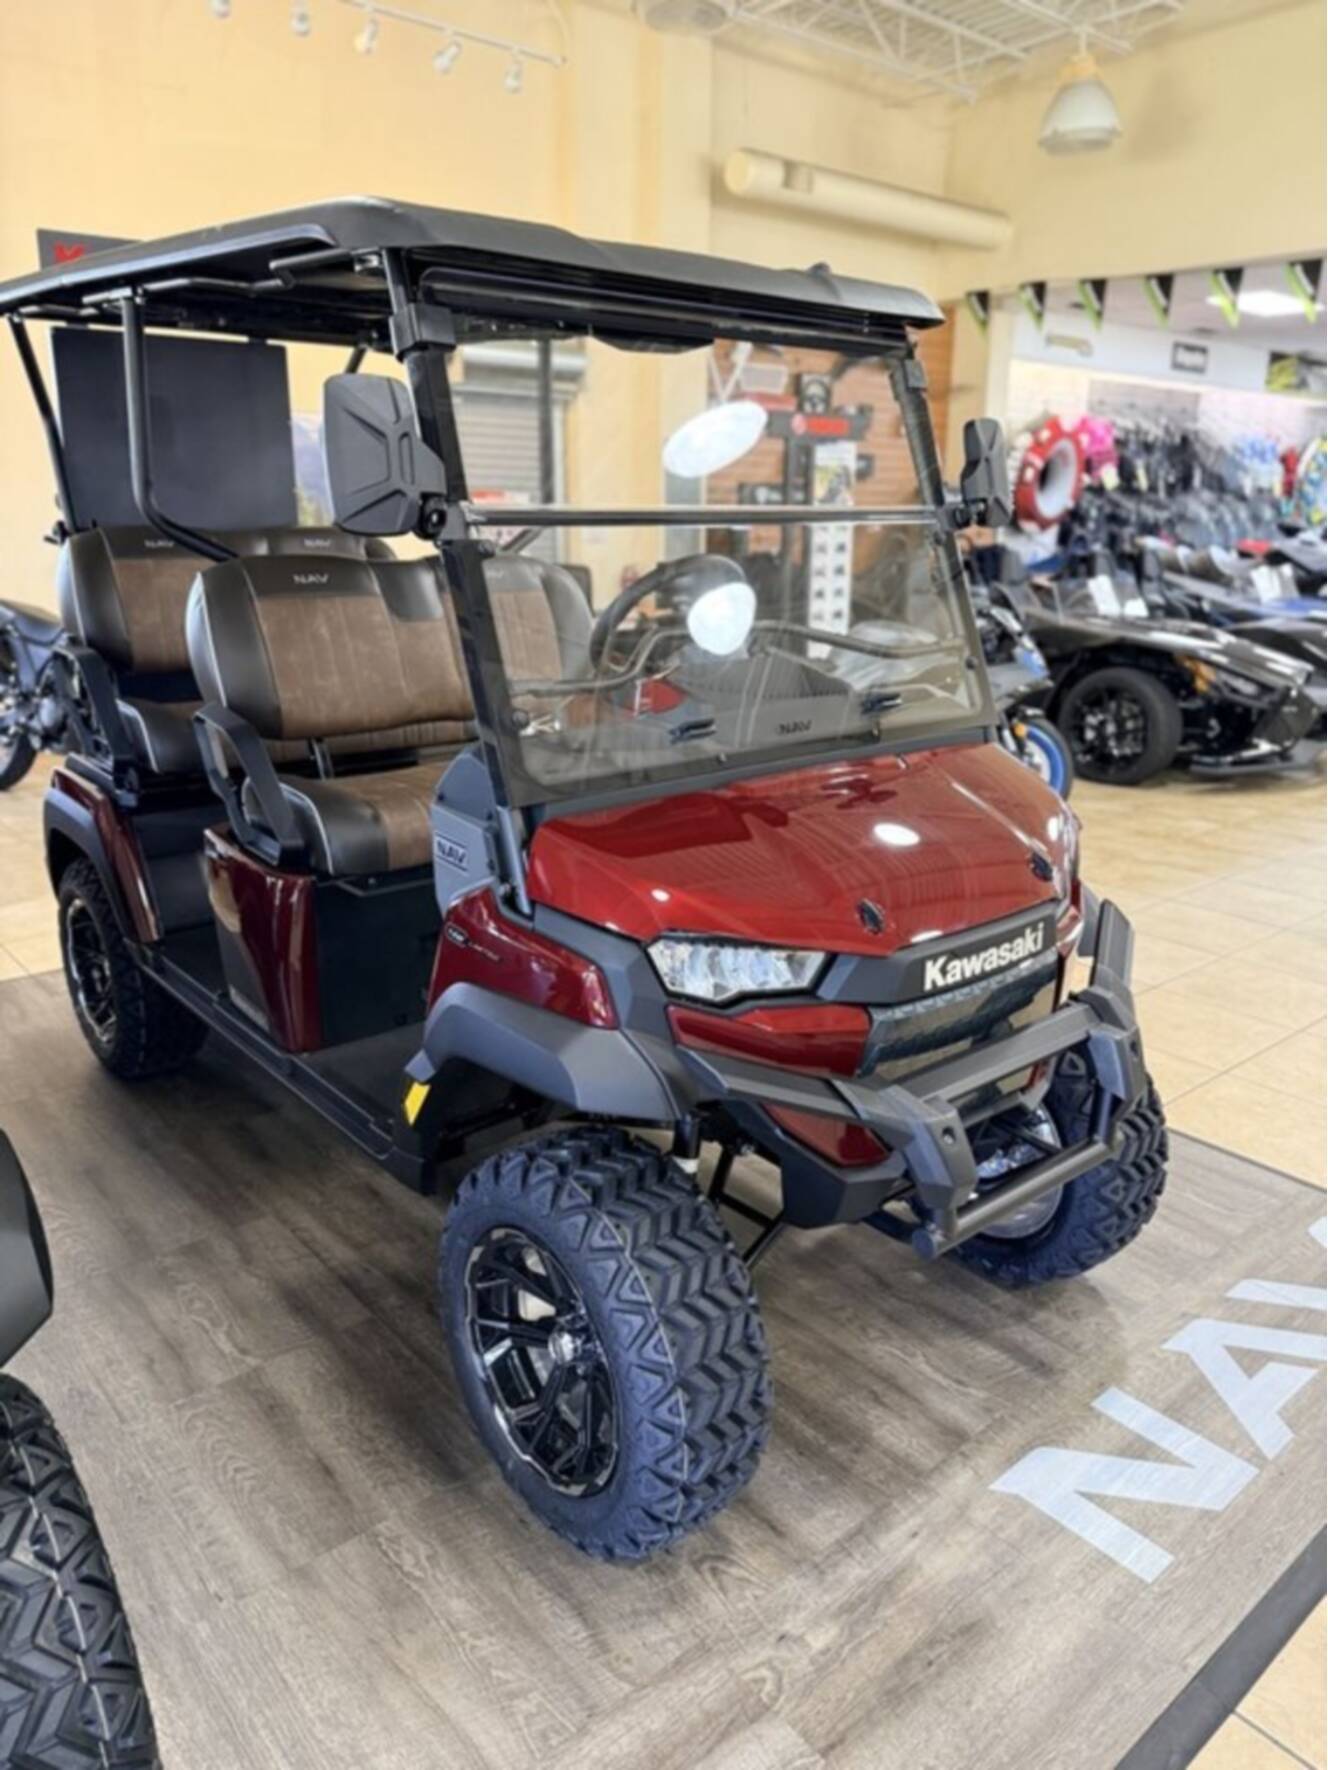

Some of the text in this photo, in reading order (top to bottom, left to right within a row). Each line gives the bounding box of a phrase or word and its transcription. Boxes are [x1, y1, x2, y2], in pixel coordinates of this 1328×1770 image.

[293, 573, 328, 584] NAV
[437, 841, 466, 863] NAV
[923, 921, 1045, 992] Kawasaki
